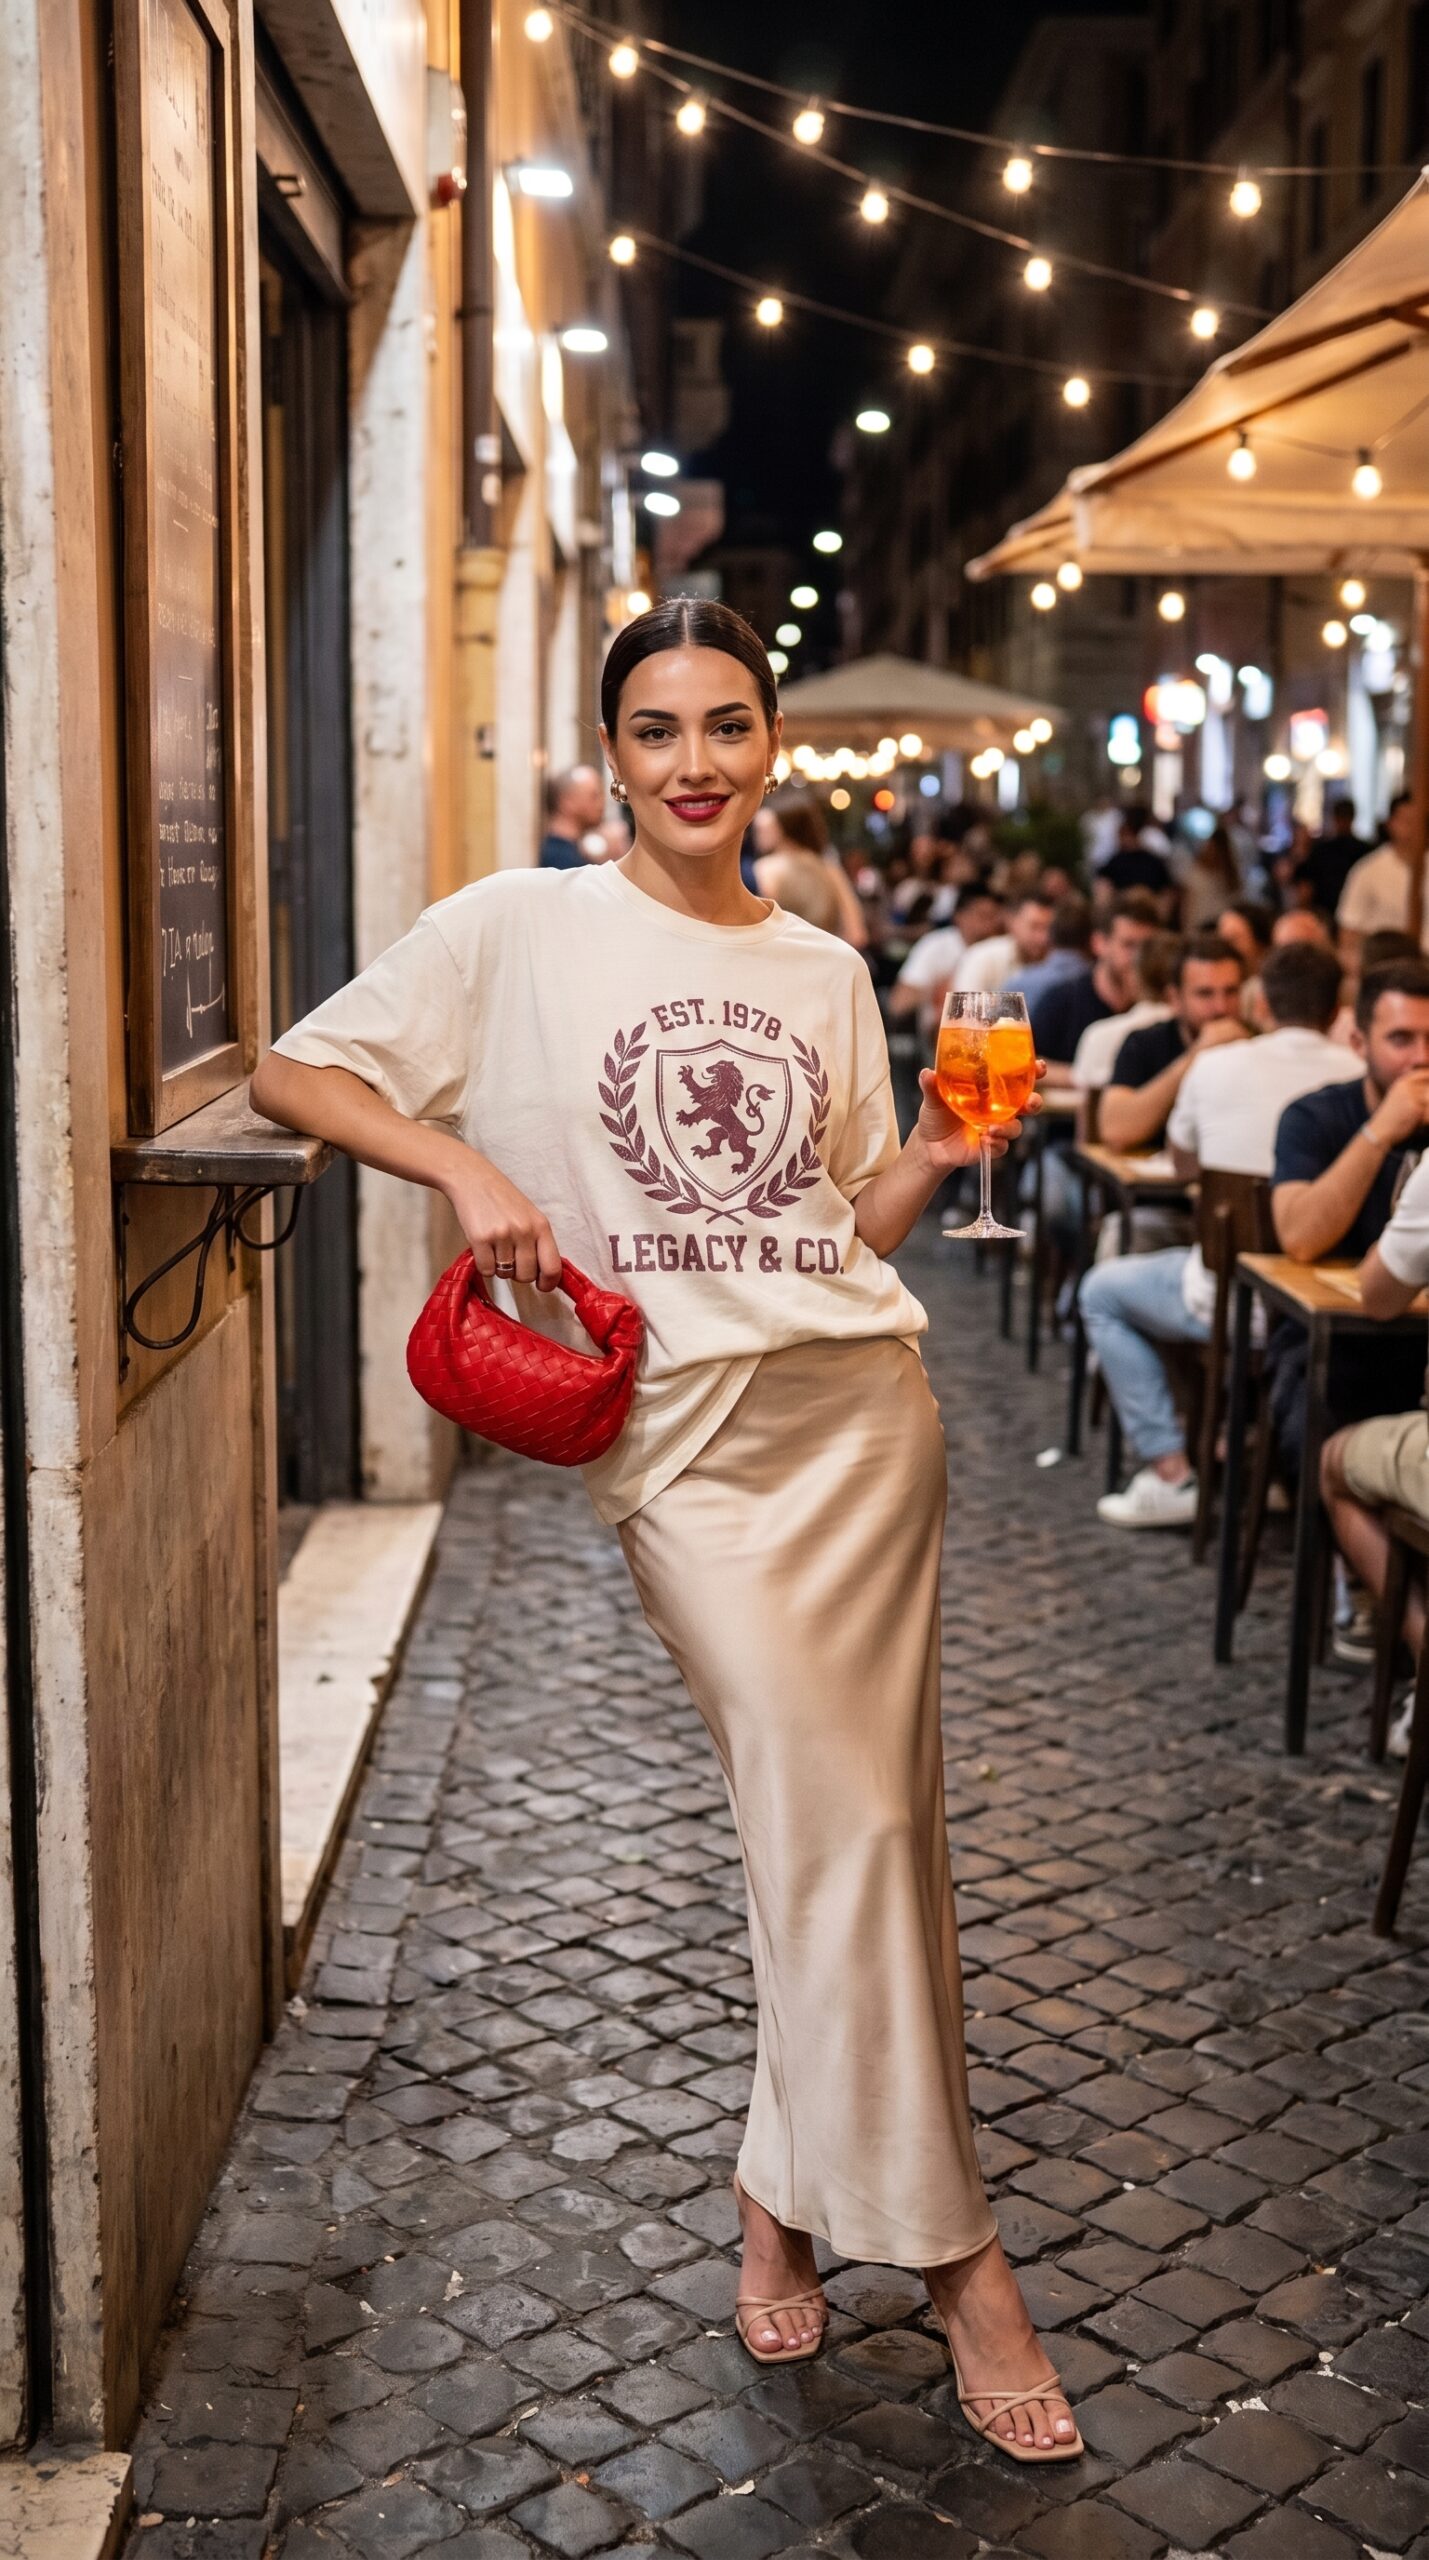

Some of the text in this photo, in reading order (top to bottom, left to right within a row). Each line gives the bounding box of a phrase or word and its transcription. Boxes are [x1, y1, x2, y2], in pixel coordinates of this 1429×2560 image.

[651, 999, 782, 1041] EST. 1978
[608, 1234, 844, 1275] LEGACY & CO.
